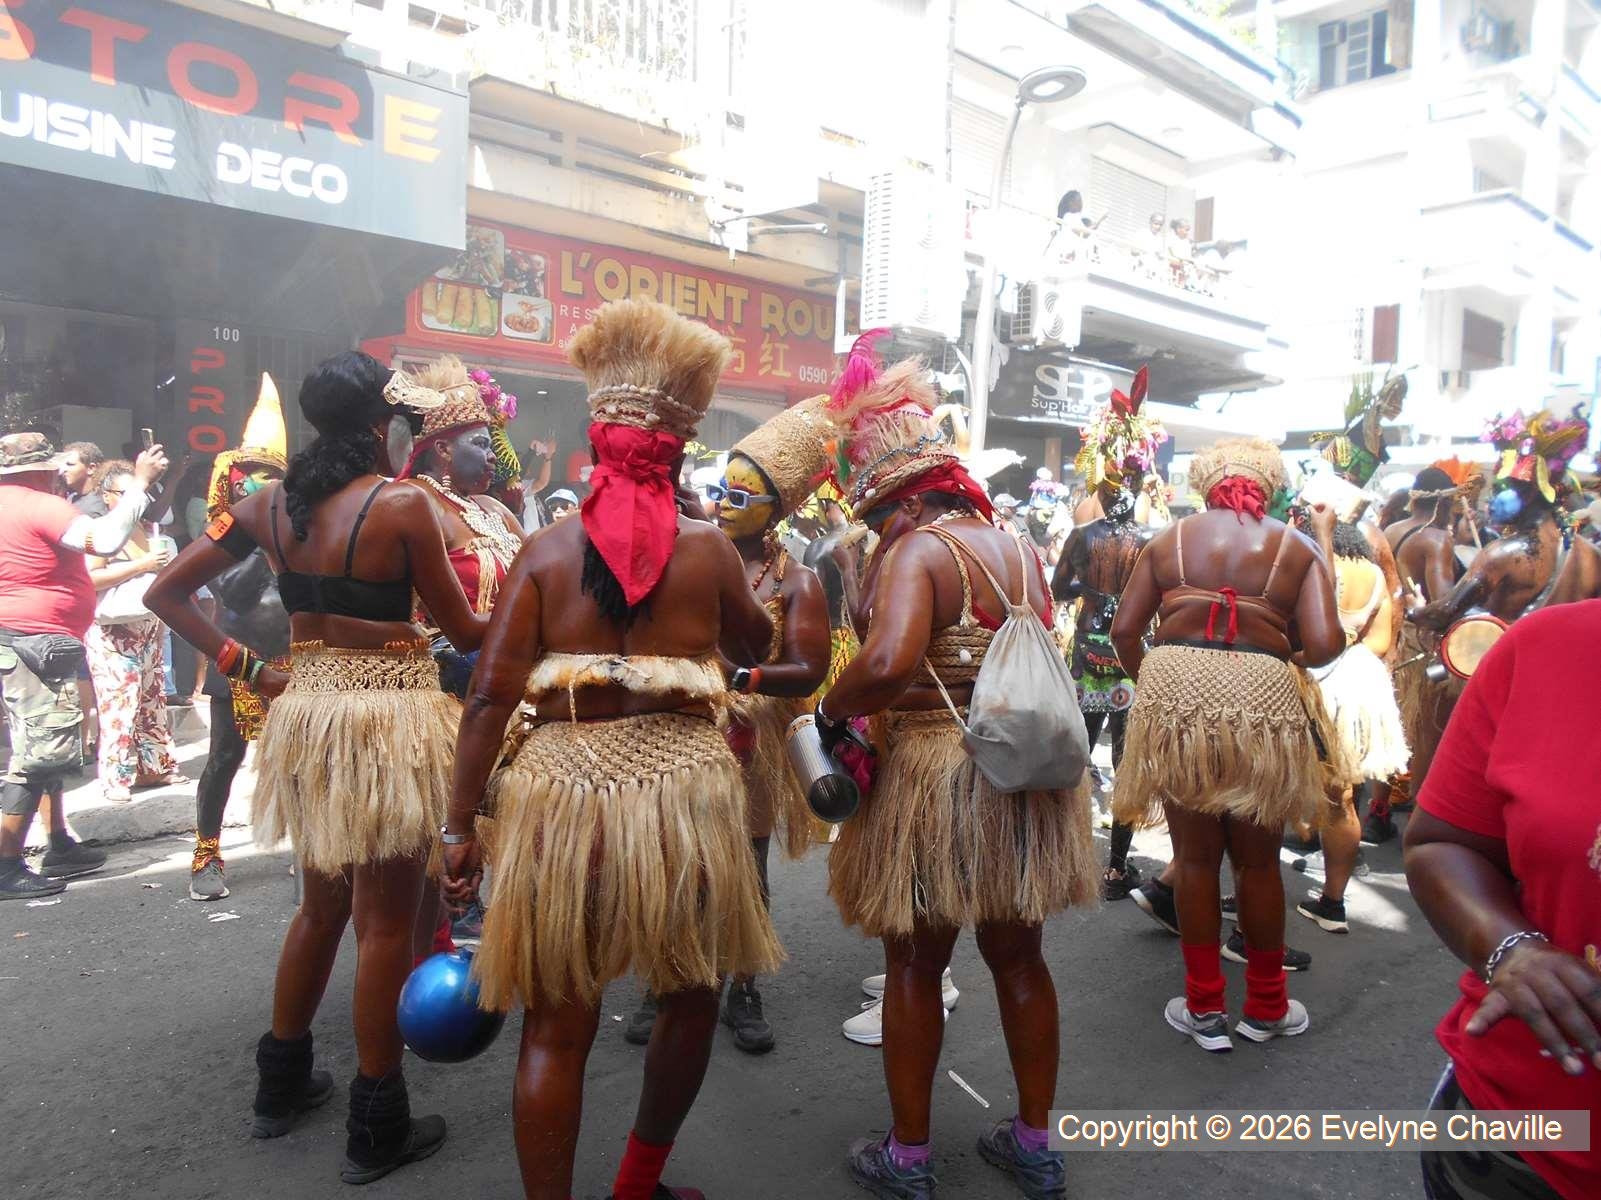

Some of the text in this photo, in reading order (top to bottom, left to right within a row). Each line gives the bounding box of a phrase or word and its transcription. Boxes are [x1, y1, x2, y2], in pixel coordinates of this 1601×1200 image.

[216, 141, 348, 204] DECO
[560, 250, 857, 341] L'ORIENT ROU
[213, 326, 240, 342] 100
[187, 346, 227, 453] PRO
[799, 365, 828, 384] 0590
